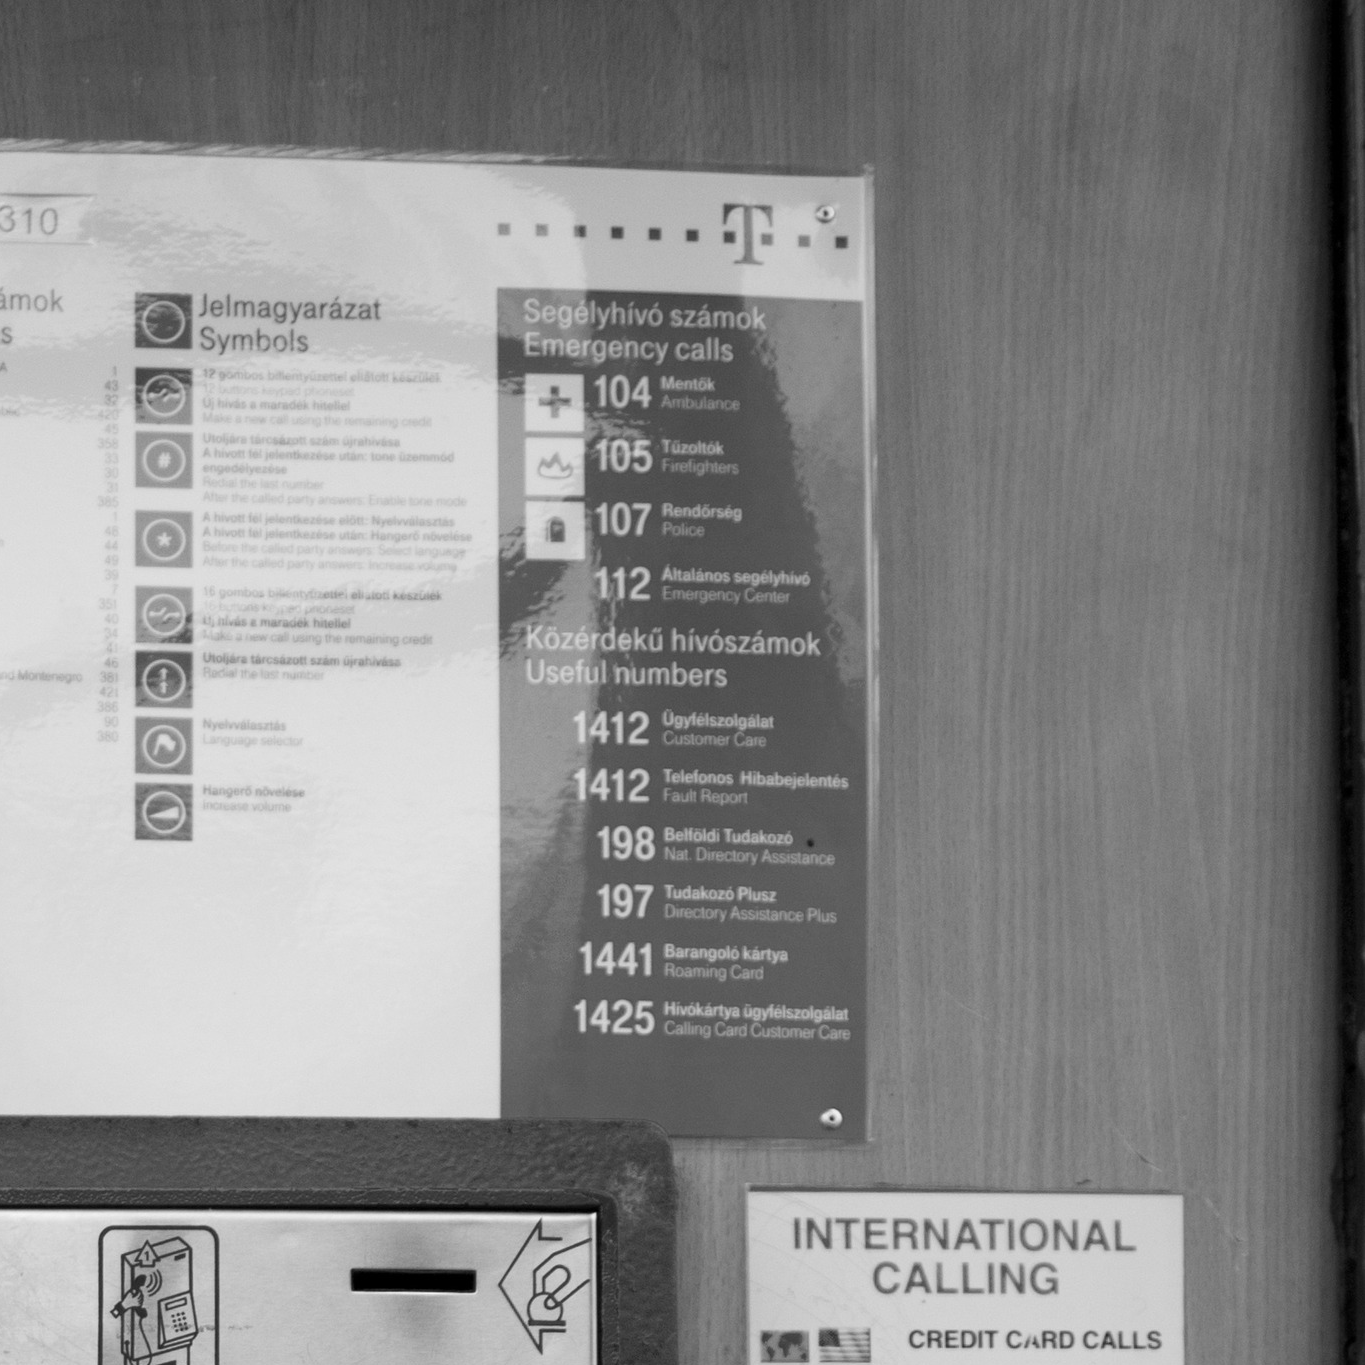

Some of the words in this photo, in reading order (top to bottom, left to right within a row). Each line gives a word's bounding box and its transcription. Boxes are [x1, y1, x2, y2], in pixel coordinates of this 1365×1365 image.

[198, 294, 381, 323] Jelmagyarázat
[522, 298, 663, 330] Segélyhívó
[669, 303, 770, 331] számok
[199, 327, 309, 355] Symbols
[521, 331, 669, 364] Emergency
[674, 337, 734, 362] calls
[594, 374, 652, 408] 104
[659, 376, 715, 391] Mentők
[660, 394, 741, 411] Ambulance
[594, 438, 653, 472] 105
[660, 438, 724, 455] Tűzoltók
[660, 457, 739, 476] Firefighters
[594, 502, 652, 536] 107
[661, 502, 742, 525] Rendőrség
[661, 522, 705, 537] Police
[592, 566, 651, 604] 112
[660, 566, 731, 587] Általános
[732, 570, 811, 589] segélyhívó
[661, 586, 741, 604] Emergency
[743, 587, 790, 603] Center
[524, 626, 662, 652] Közérdekű
[671, 628, 821, 655] hívószámok
[526, 660, 607, 685] Useful
[612, 662, 728, 687] numbers
[572, 709, 650, 746] 1412
[662, 709, 774, 731] Ügyfélszolgálat
[662, 731, 731, 746] Customer
[732, 731, 767, 747] Care
[571, 766, 650, 802] 1412
[662, 768, 734, 785] Telefonos
[739, 770, 849, 789] Hibabejelentés
[662, 787, 697, 803] Fault
[699, 788, 748, 806] Report
[596, 825, 656, 860] 198
[663, 826, 720, 843] Belföldi
[722, 828, 794, 845] Tudakozó
[663, 846, 692, 861] Nat.
[695, 846, 758, 865] Directory
[760, 849, 835, 865] Assistance
[597, 883, 654, 918] 197
[663, 884, 735, 900] Tudakozó
[736, 886, 777, 902] Plusz
[663, 903, 727, 922] Directory
[729, 906, 804, 922] Assistance
[806, 907, 837, 923] Plus
[578, 941, 652, 976] 1441
[663, 943, 740, 963] Barangoló
[741, 946, 789, 964] kártya
[663, 965, 727, 982] Roaming
[728, 963, 764, 980] Card
[573, 999, 655, 1034] 1425
[663, 1002, 741, 1021] Hívókártya
[742, 1004, 849, 1026] ügyfélszolgálat
[663, 1021, 712, 1039] Calling
[713, 1021, 748, 1037] Card
[749, 1022, 816, 1039] Customer
[817, 1024, 851, 1040] Care
[793, 1217, 1136, 1251] INTERNATIONAL
[872, 1262, 1058, 1294] CALLING
[908, 1329, 998, 1349] CREDIT
[1005, 1330, 1075, 1349] CARD
[1082, 1330, 1162, 1350] CALLS
